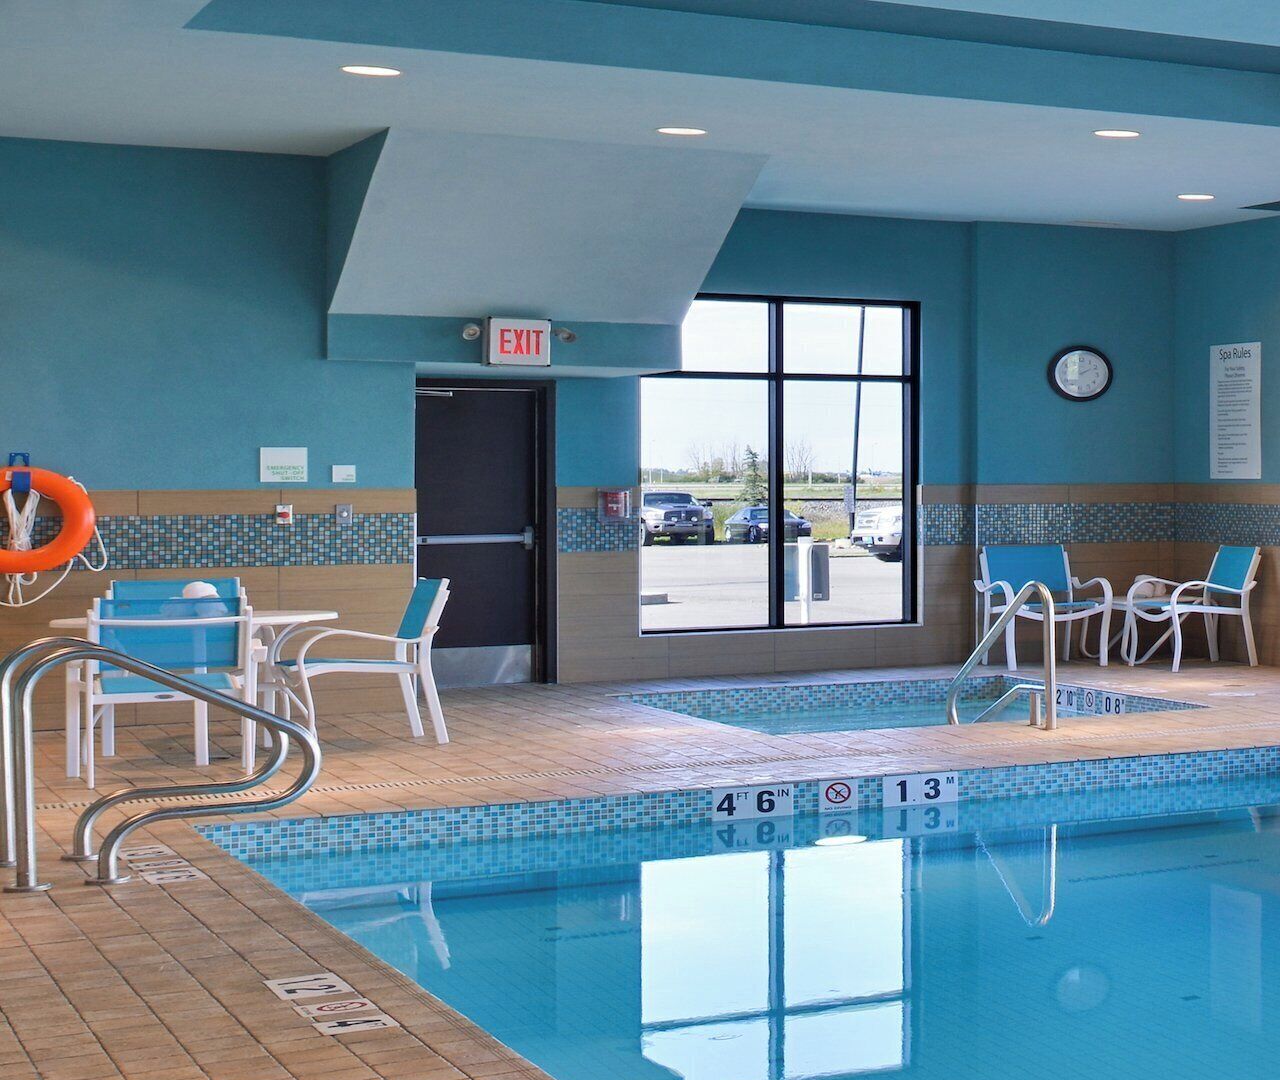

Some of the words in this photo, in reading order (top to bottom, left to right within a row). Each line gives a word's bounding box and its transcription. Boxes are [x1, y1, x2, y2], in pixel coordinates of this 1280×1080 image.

[499, 328, 544, 355] EXIT
[1219, 348, 1232, 362] Spa
[1232, 347, 1252, 359] Rules
